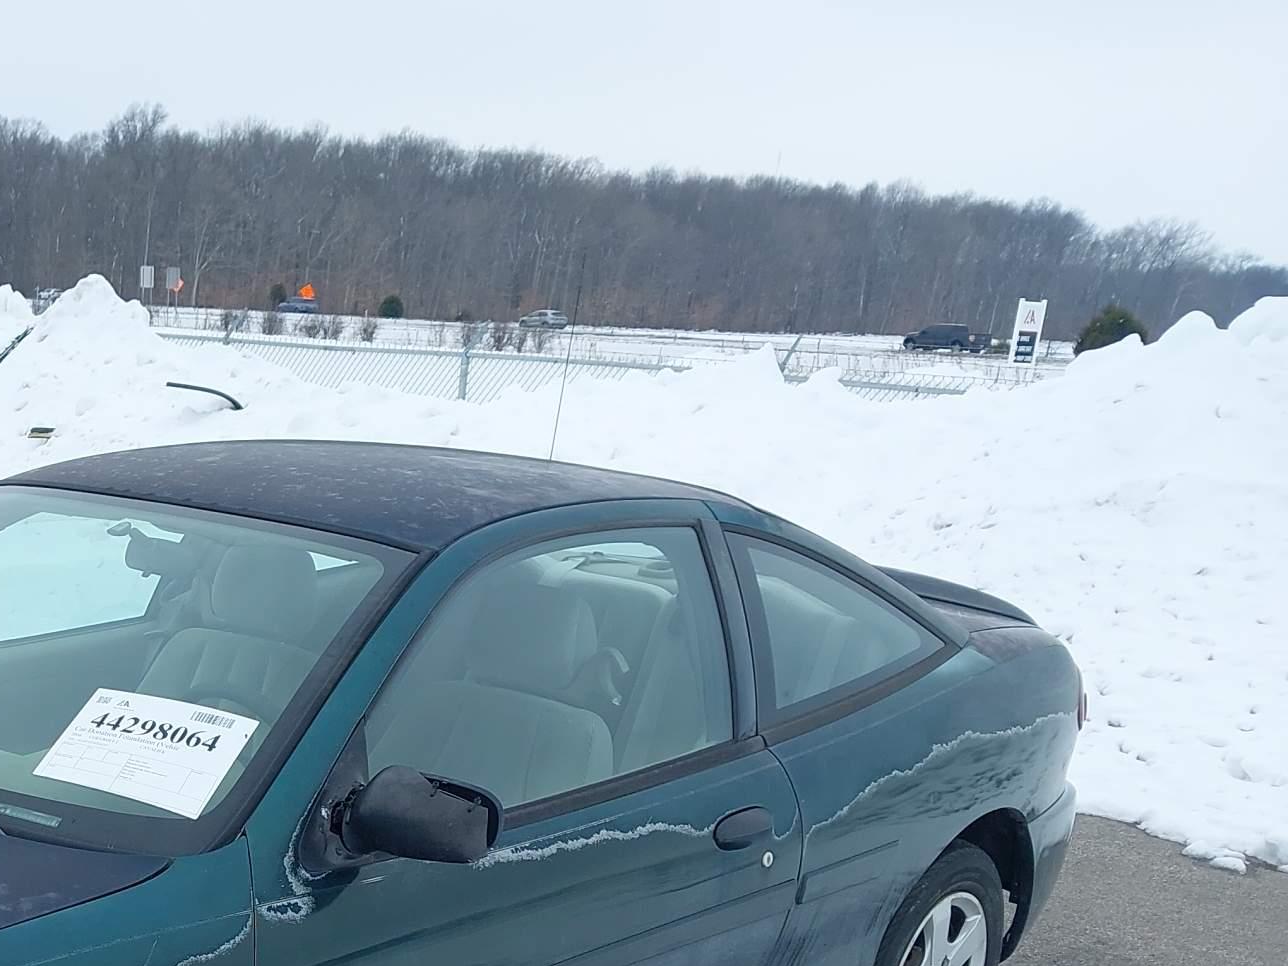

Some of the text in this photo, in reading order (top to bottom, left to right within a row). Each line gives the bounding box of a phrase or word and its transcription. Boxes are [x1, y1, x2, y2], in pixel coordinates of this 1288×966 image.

[88, 727, 116, 739] Donation
[117, 734, 156, 747] Foundation
[90, 712, 221, 752] 44298064
